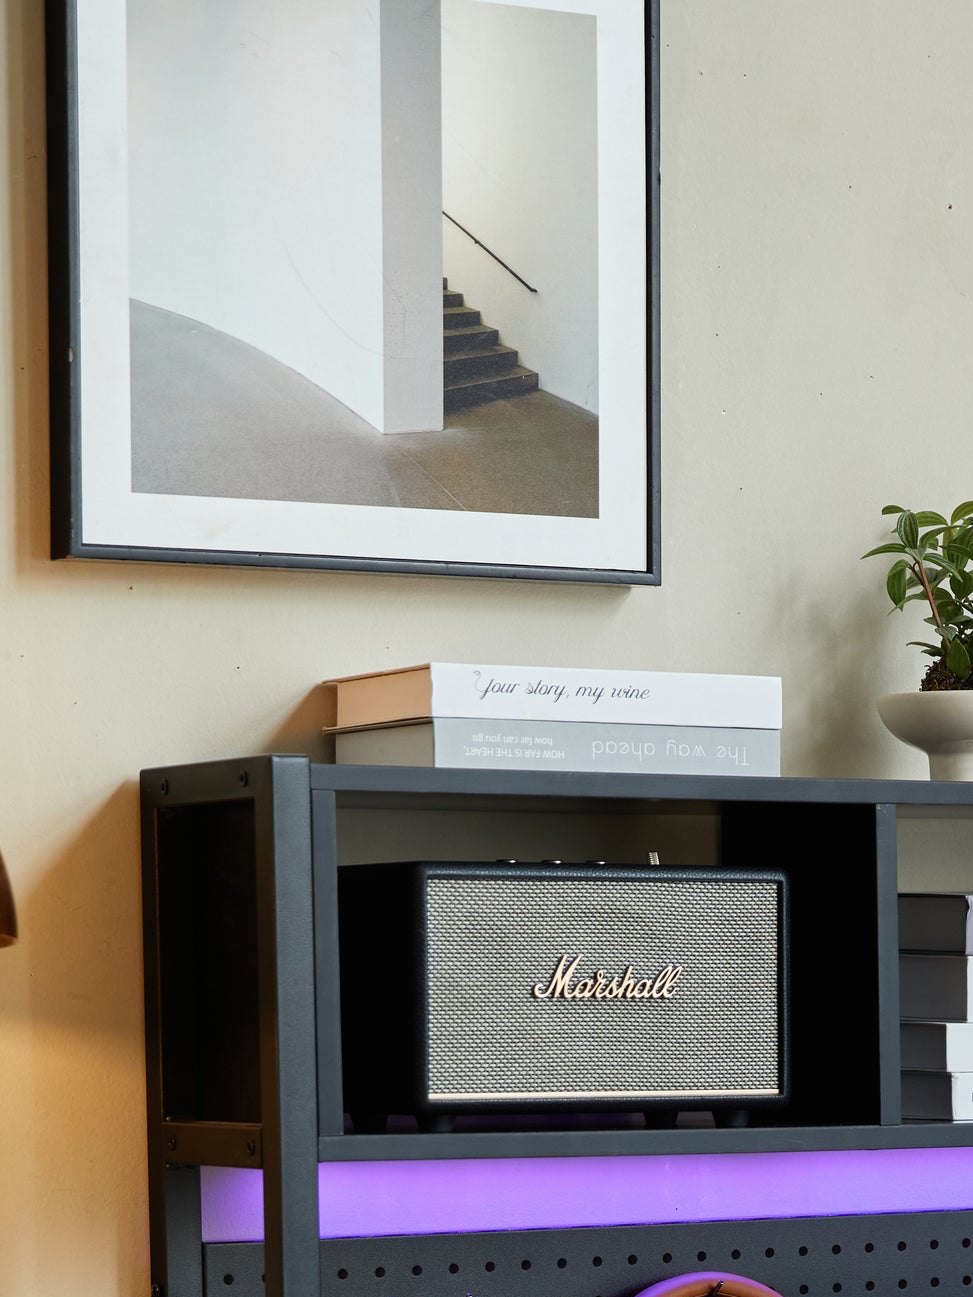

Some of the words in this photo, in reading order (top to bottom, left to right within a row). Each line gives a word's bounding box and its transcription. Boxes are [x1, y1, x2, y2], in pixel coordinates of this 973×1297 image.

[575, 685, 604, 704] my
[611, 685, 650, 700] wine
[472, 732, 484, 742] go
[486, 733, 501, 742] you
[520, 736, 532, 746] far
[534, 737, 552, 746] how
[496, 747, 513, 757] THE
[514, 748, 522, 758] IS
[524, 749, 541, 758] FAR
[592, 740, 656, 762] ahead
[666, 740, 706, 757] way
[542, 750, 565, 759] HOW
[716, 745, 750, 766] The
[533, 954, 683, 999] Marshall
